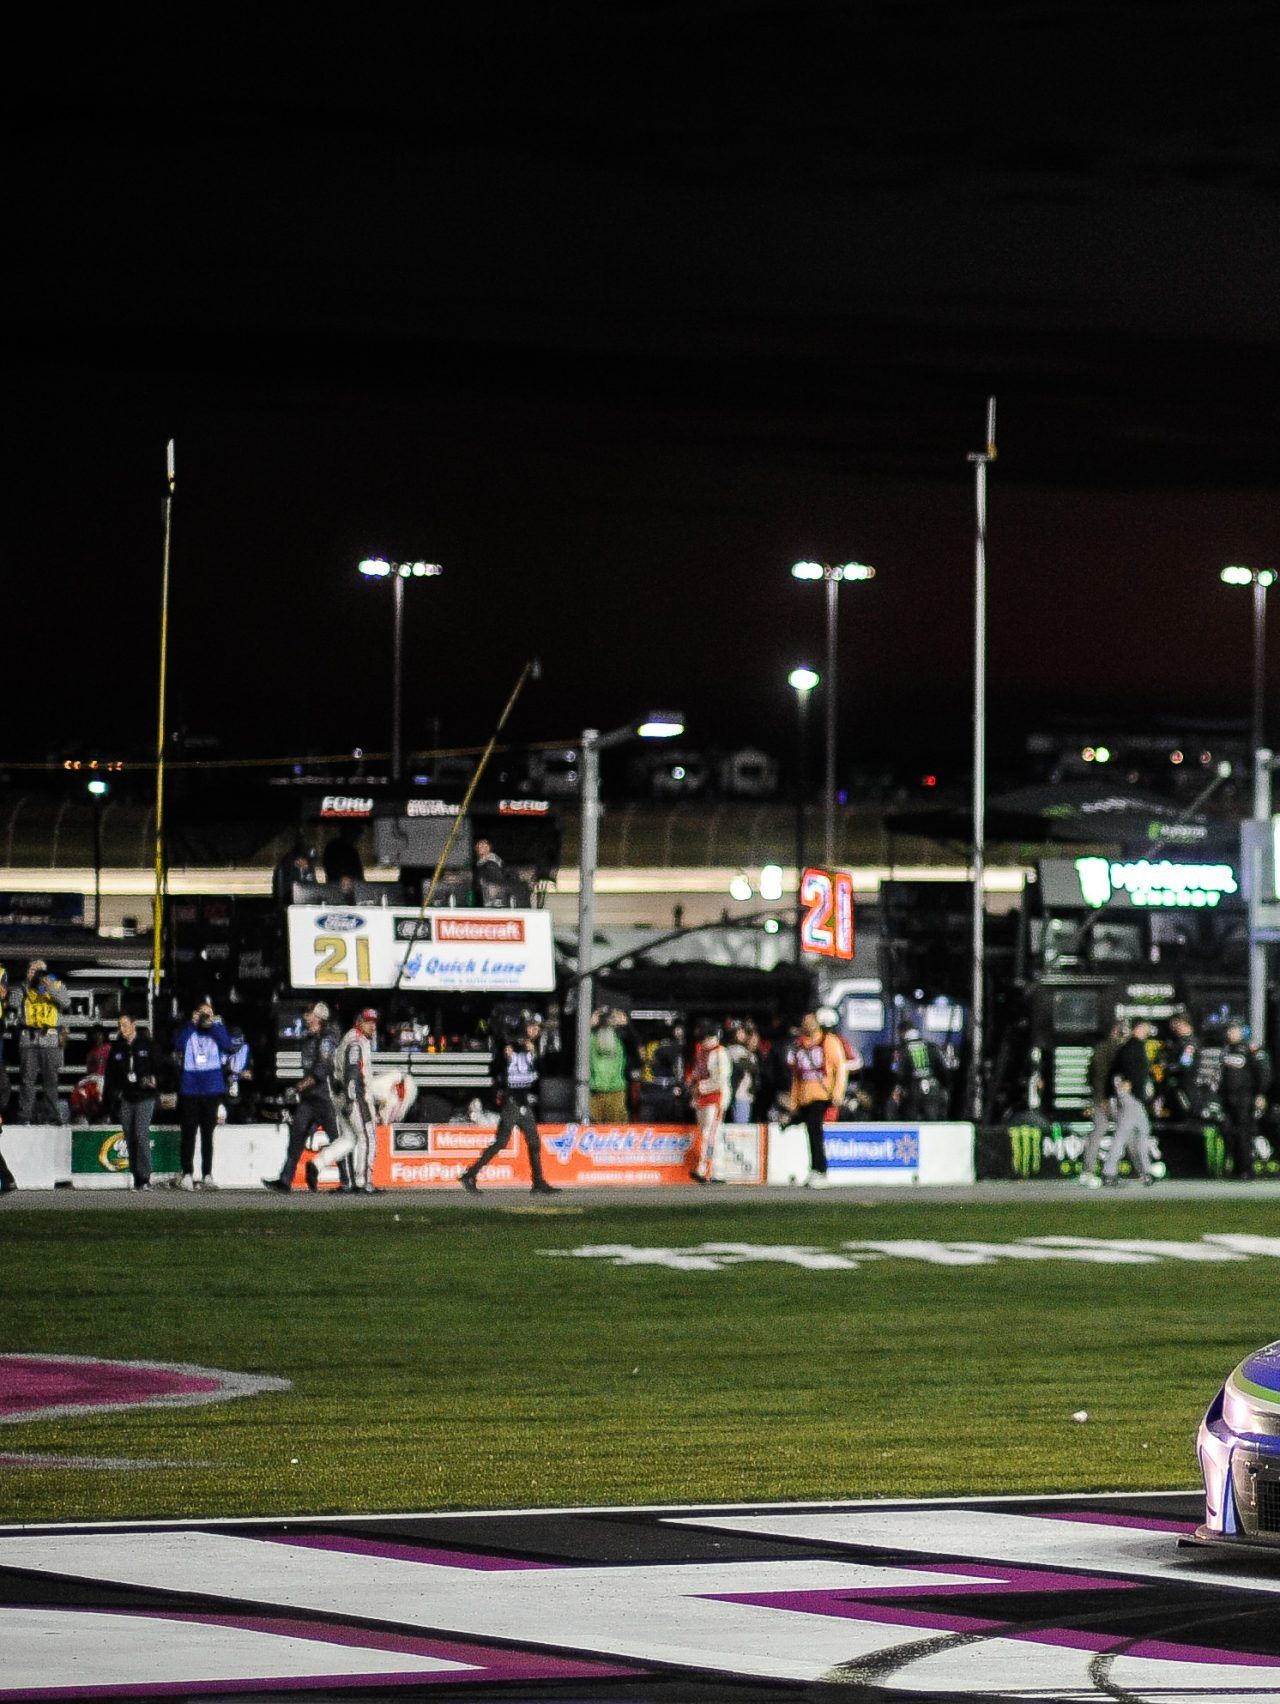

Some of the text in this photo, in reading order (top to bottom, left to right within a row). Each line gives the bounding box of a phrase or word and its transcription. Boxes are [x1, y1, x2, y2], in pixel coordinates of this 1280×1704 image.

[803, 869, 854, 960] 21
[440, 920, 520, 939] Motorcraft
[314, 936, 371, 985] 21
[426, 957, 526, 975] Quick Lane
[824, 1137, 894, 1161] Walmart
[392, 1162, 513, 1182] FordPartcom
